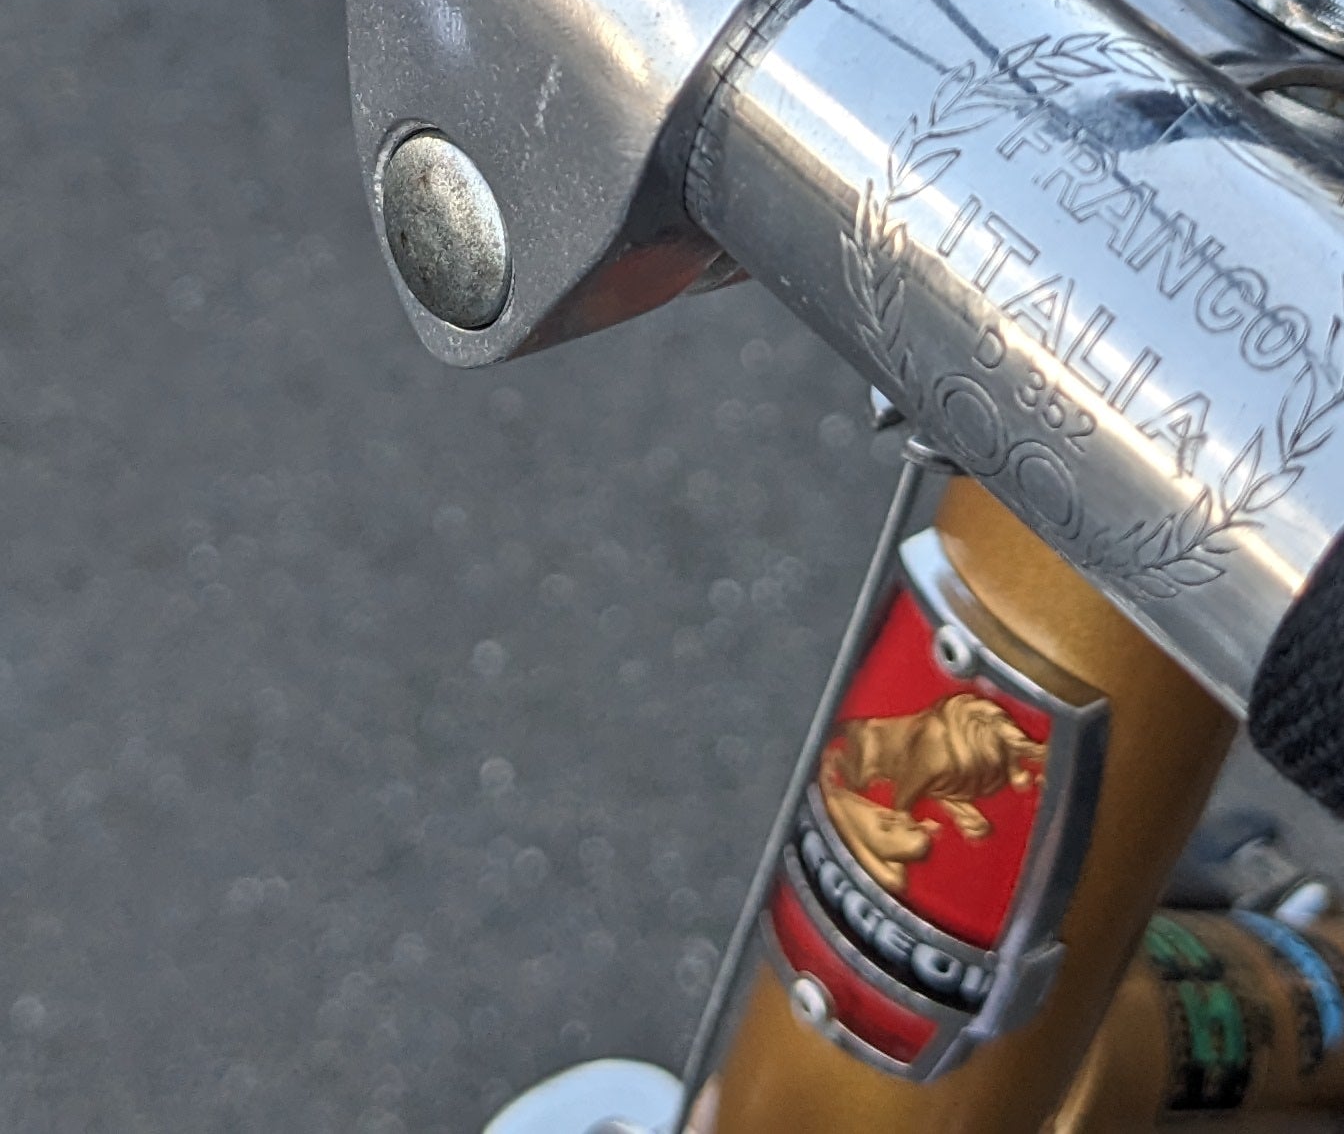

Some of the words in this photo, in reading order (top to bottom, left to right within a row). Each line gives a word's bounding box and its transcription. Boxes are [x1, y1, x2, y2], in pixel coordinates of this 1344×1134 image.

[936, 194, 1212, 476] ITALIA
[996, 112, 1312, 370] FRANCO
[971, 324, 1008, 370] D
[1015, 369, 1097, 454] 352
